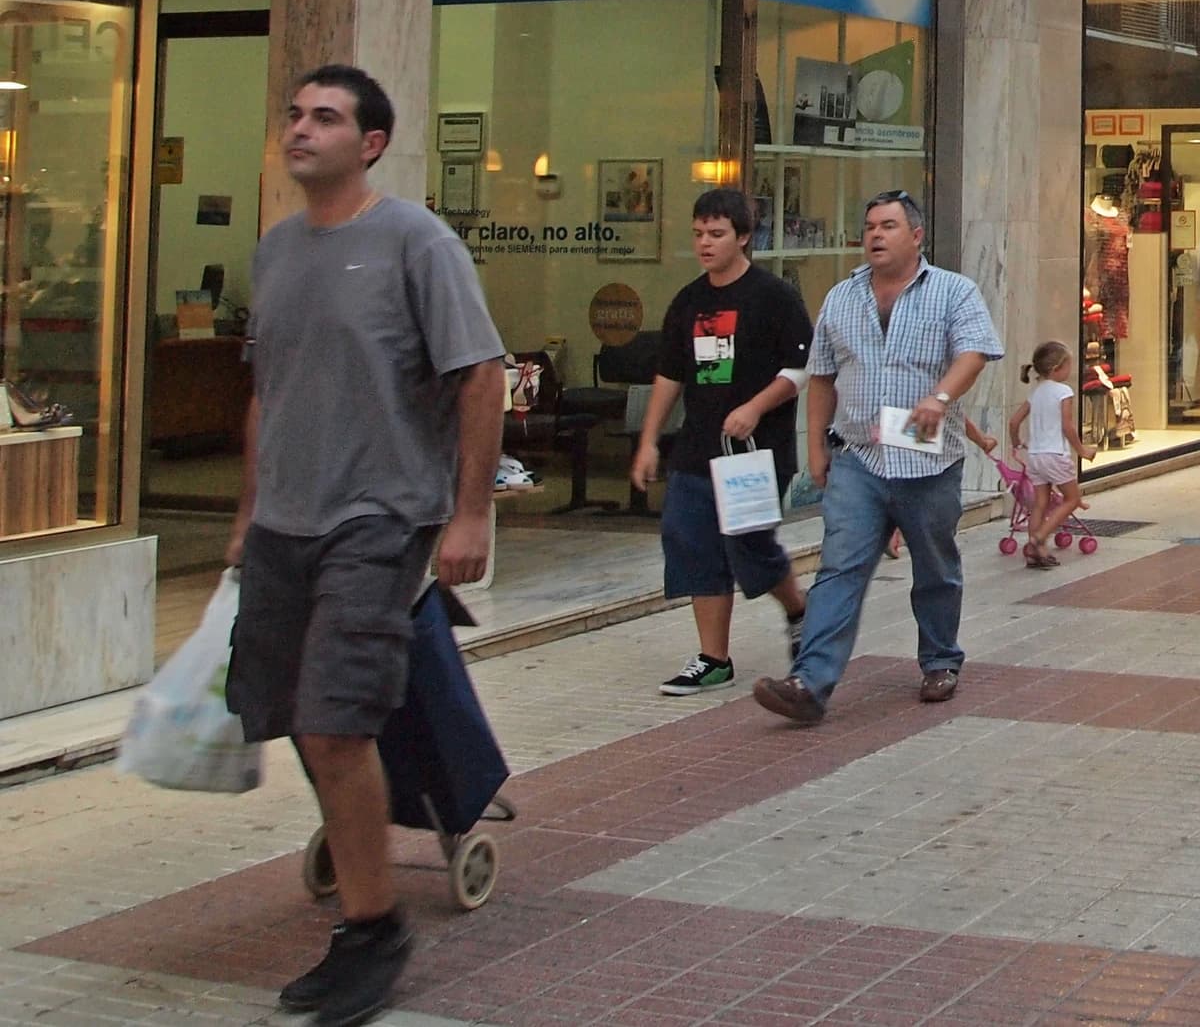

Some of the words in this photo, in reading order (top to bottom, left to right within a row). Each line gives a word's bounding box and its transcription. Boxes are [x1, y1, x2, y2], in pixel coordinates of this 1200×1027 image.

[479, 222, 535, 244] claro,
[543, 227, 568, 241] no
[575, 222, 620, 241] alto.
[494, 244, 506, 253] de
[507, 245, 548, 254] SIEMENS
[549, 246, 568, 256] para
[570, 245, 608, 254] entender
[610, 245, 635, 256] mejor
